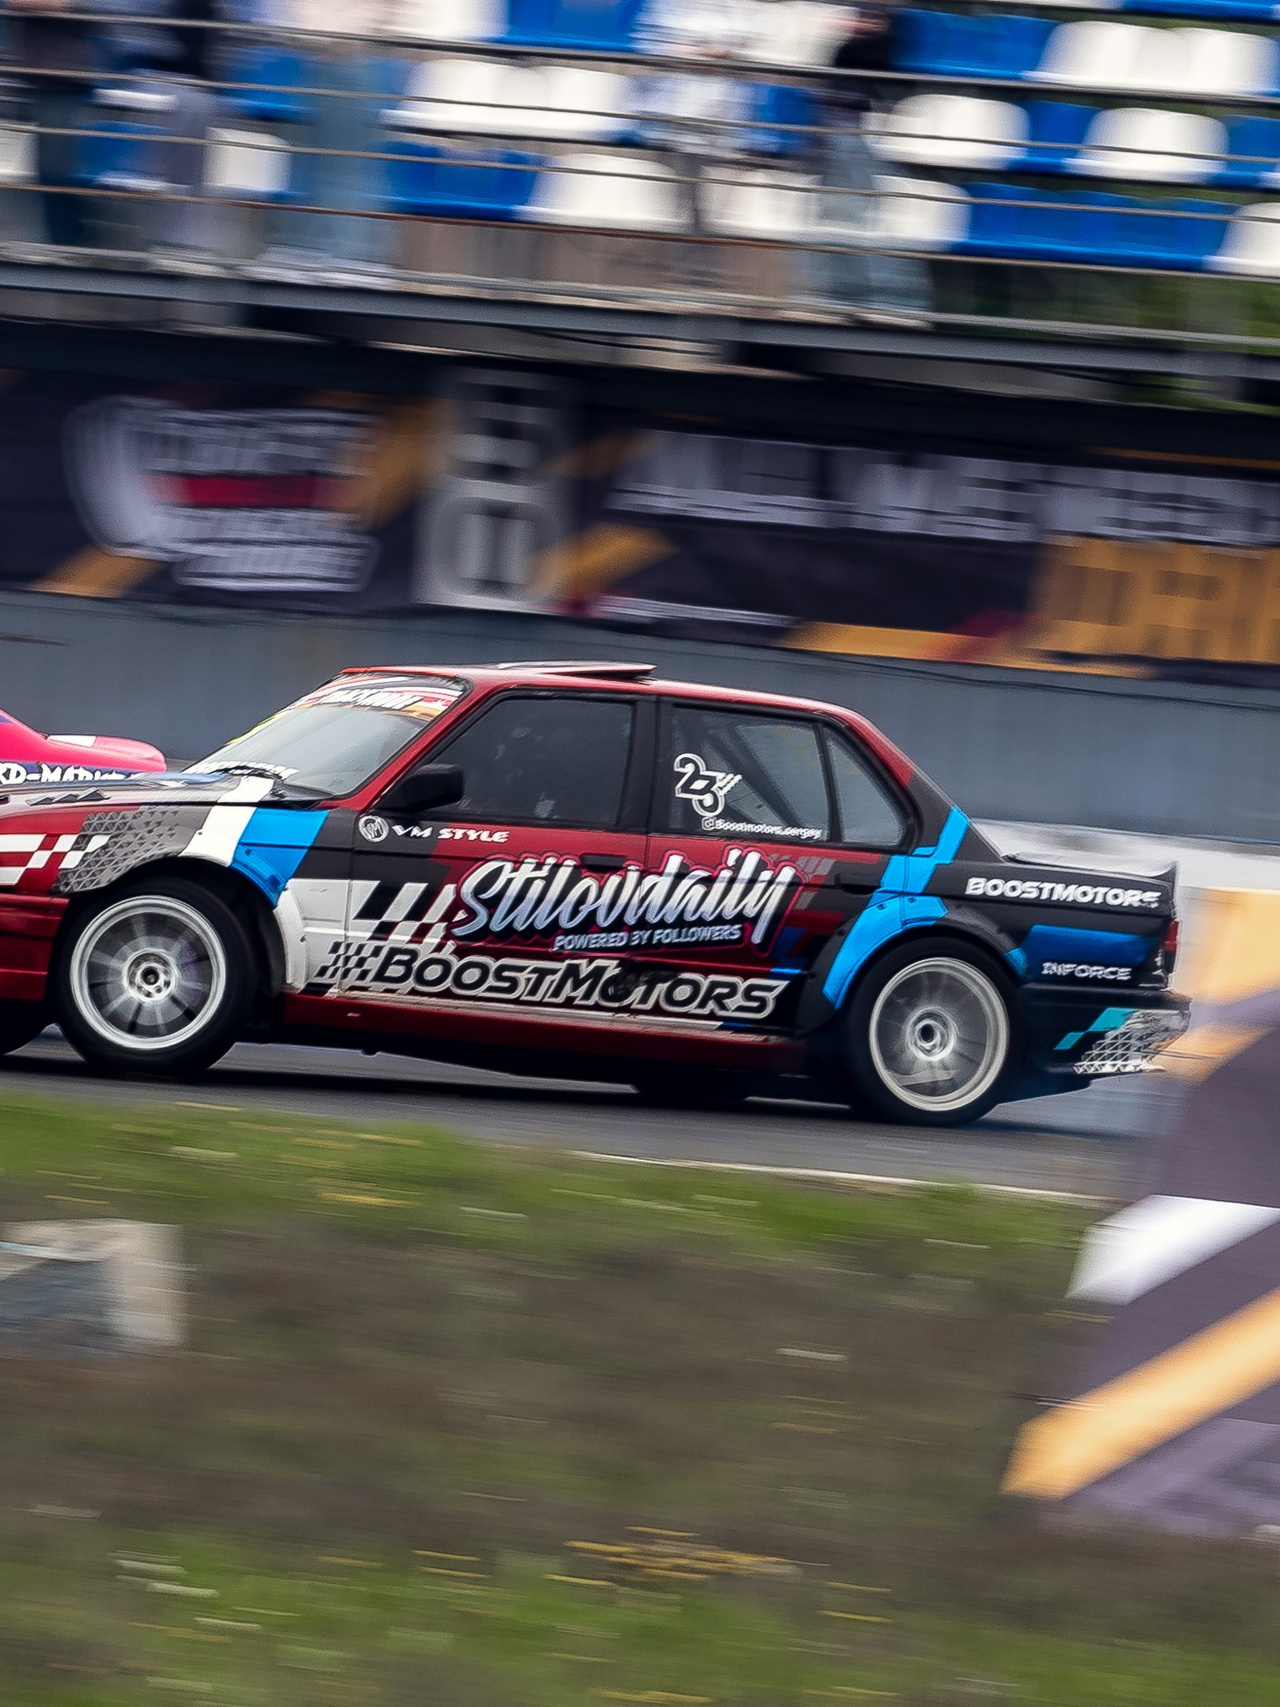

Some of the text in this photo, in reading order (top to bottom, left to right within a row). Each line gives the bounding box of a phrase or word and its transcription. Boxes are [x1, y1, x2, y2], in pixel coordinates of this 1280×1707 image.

[437, 828, 510, 843] STYLE
[965, 877, 1161, 908] BOOSTMOTORS
[553, 932, 629, 951] POWERED
[652, 924, 742, 944] FOLLOWERS
